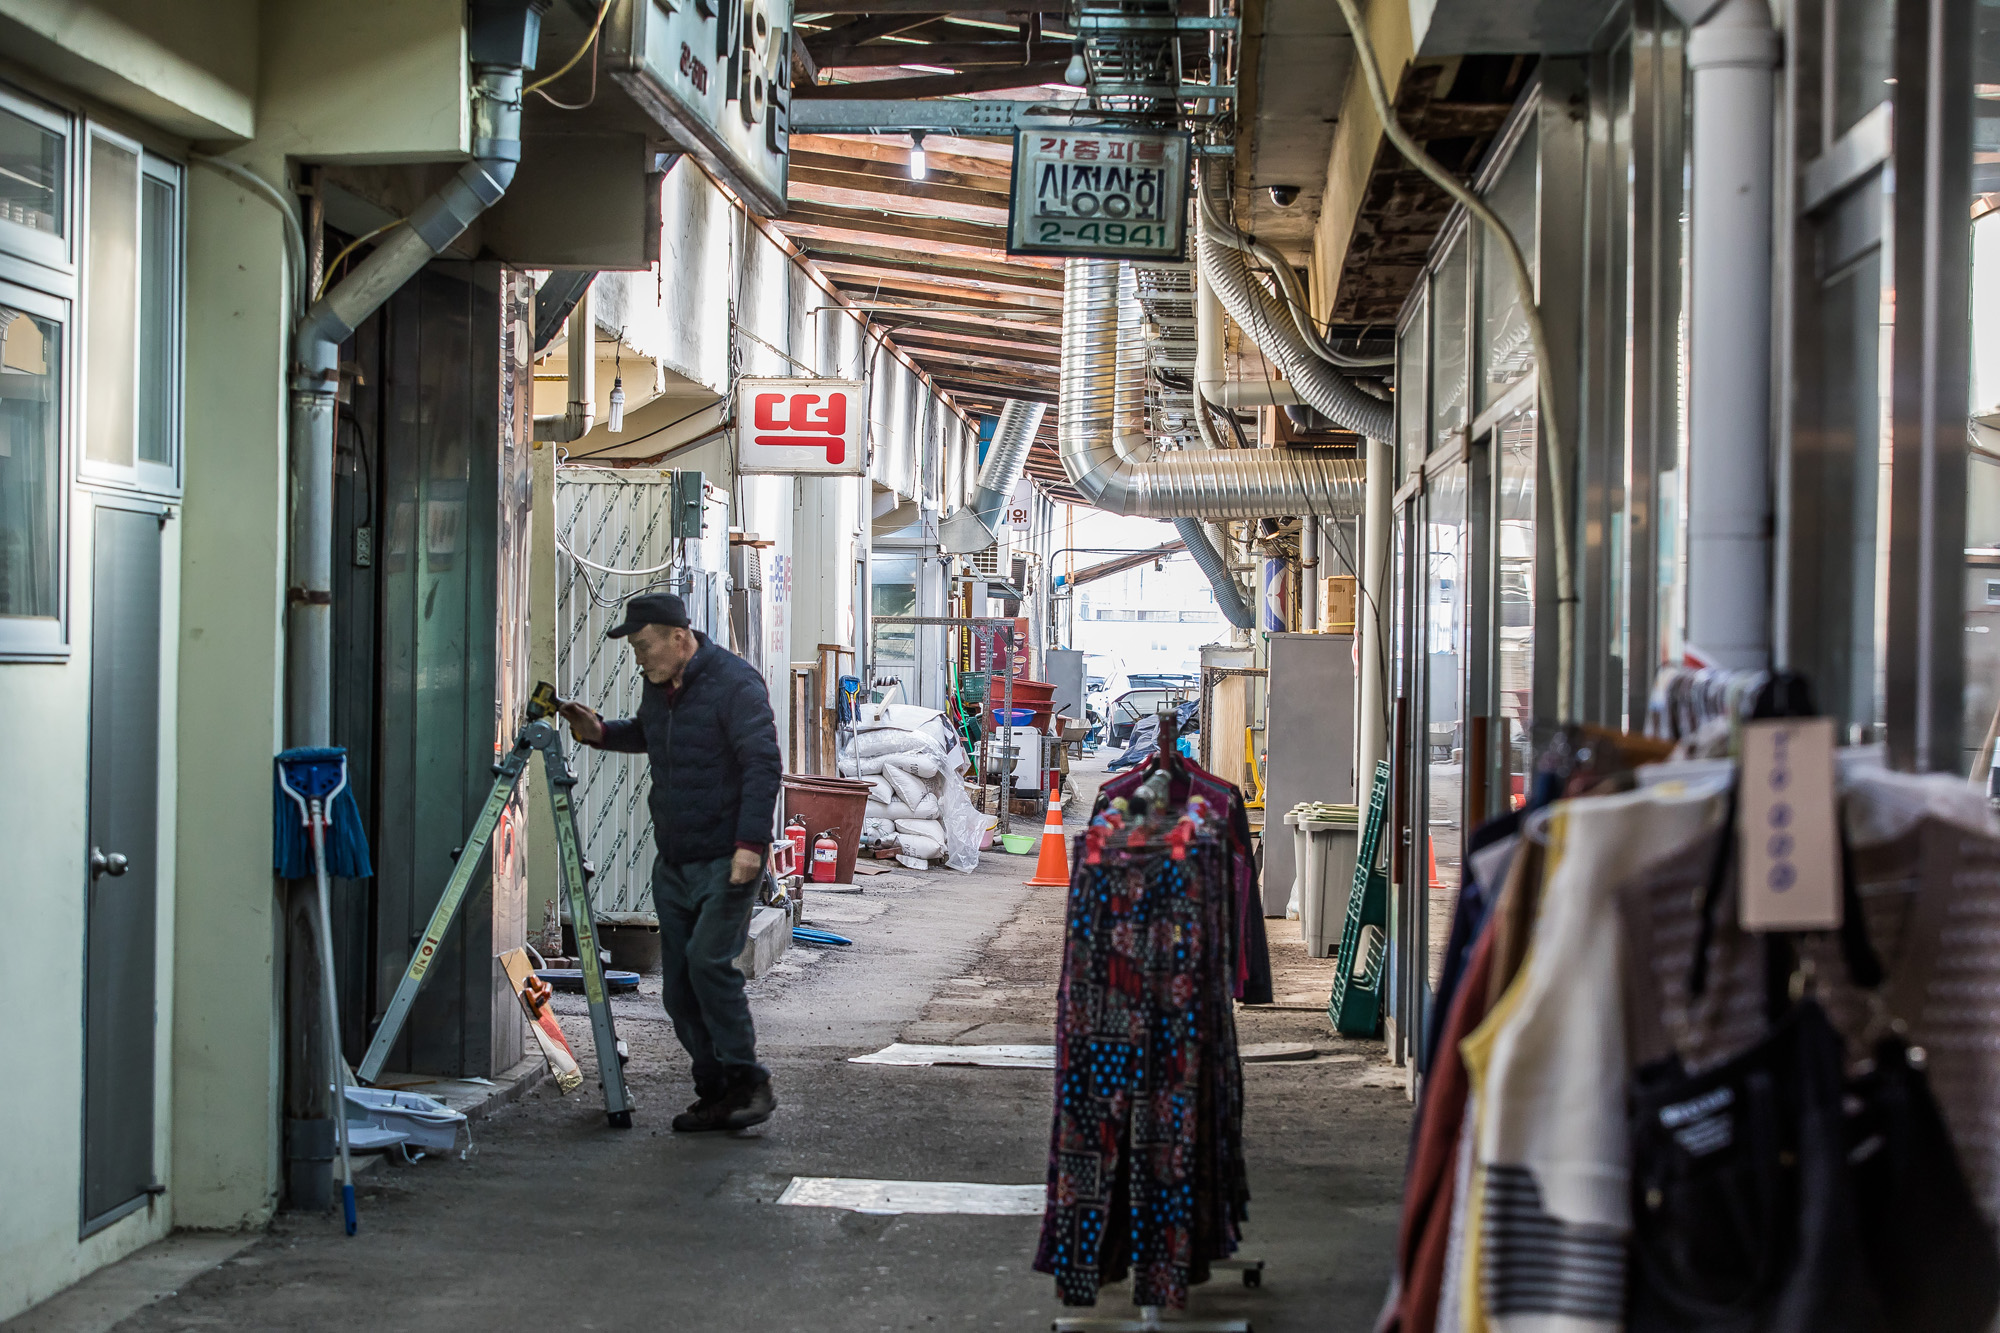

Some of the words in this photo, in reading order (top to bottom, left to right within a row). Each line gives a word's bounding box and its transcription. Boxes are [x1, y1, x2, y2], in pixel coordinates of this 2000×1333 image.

[1038, 163, 1166, 222] 신정상회
[1040, 222, 1165, 248] 2-4941
[754, 393, 847, 465] 떡
[1006, 509, 1028, 523] 유!
